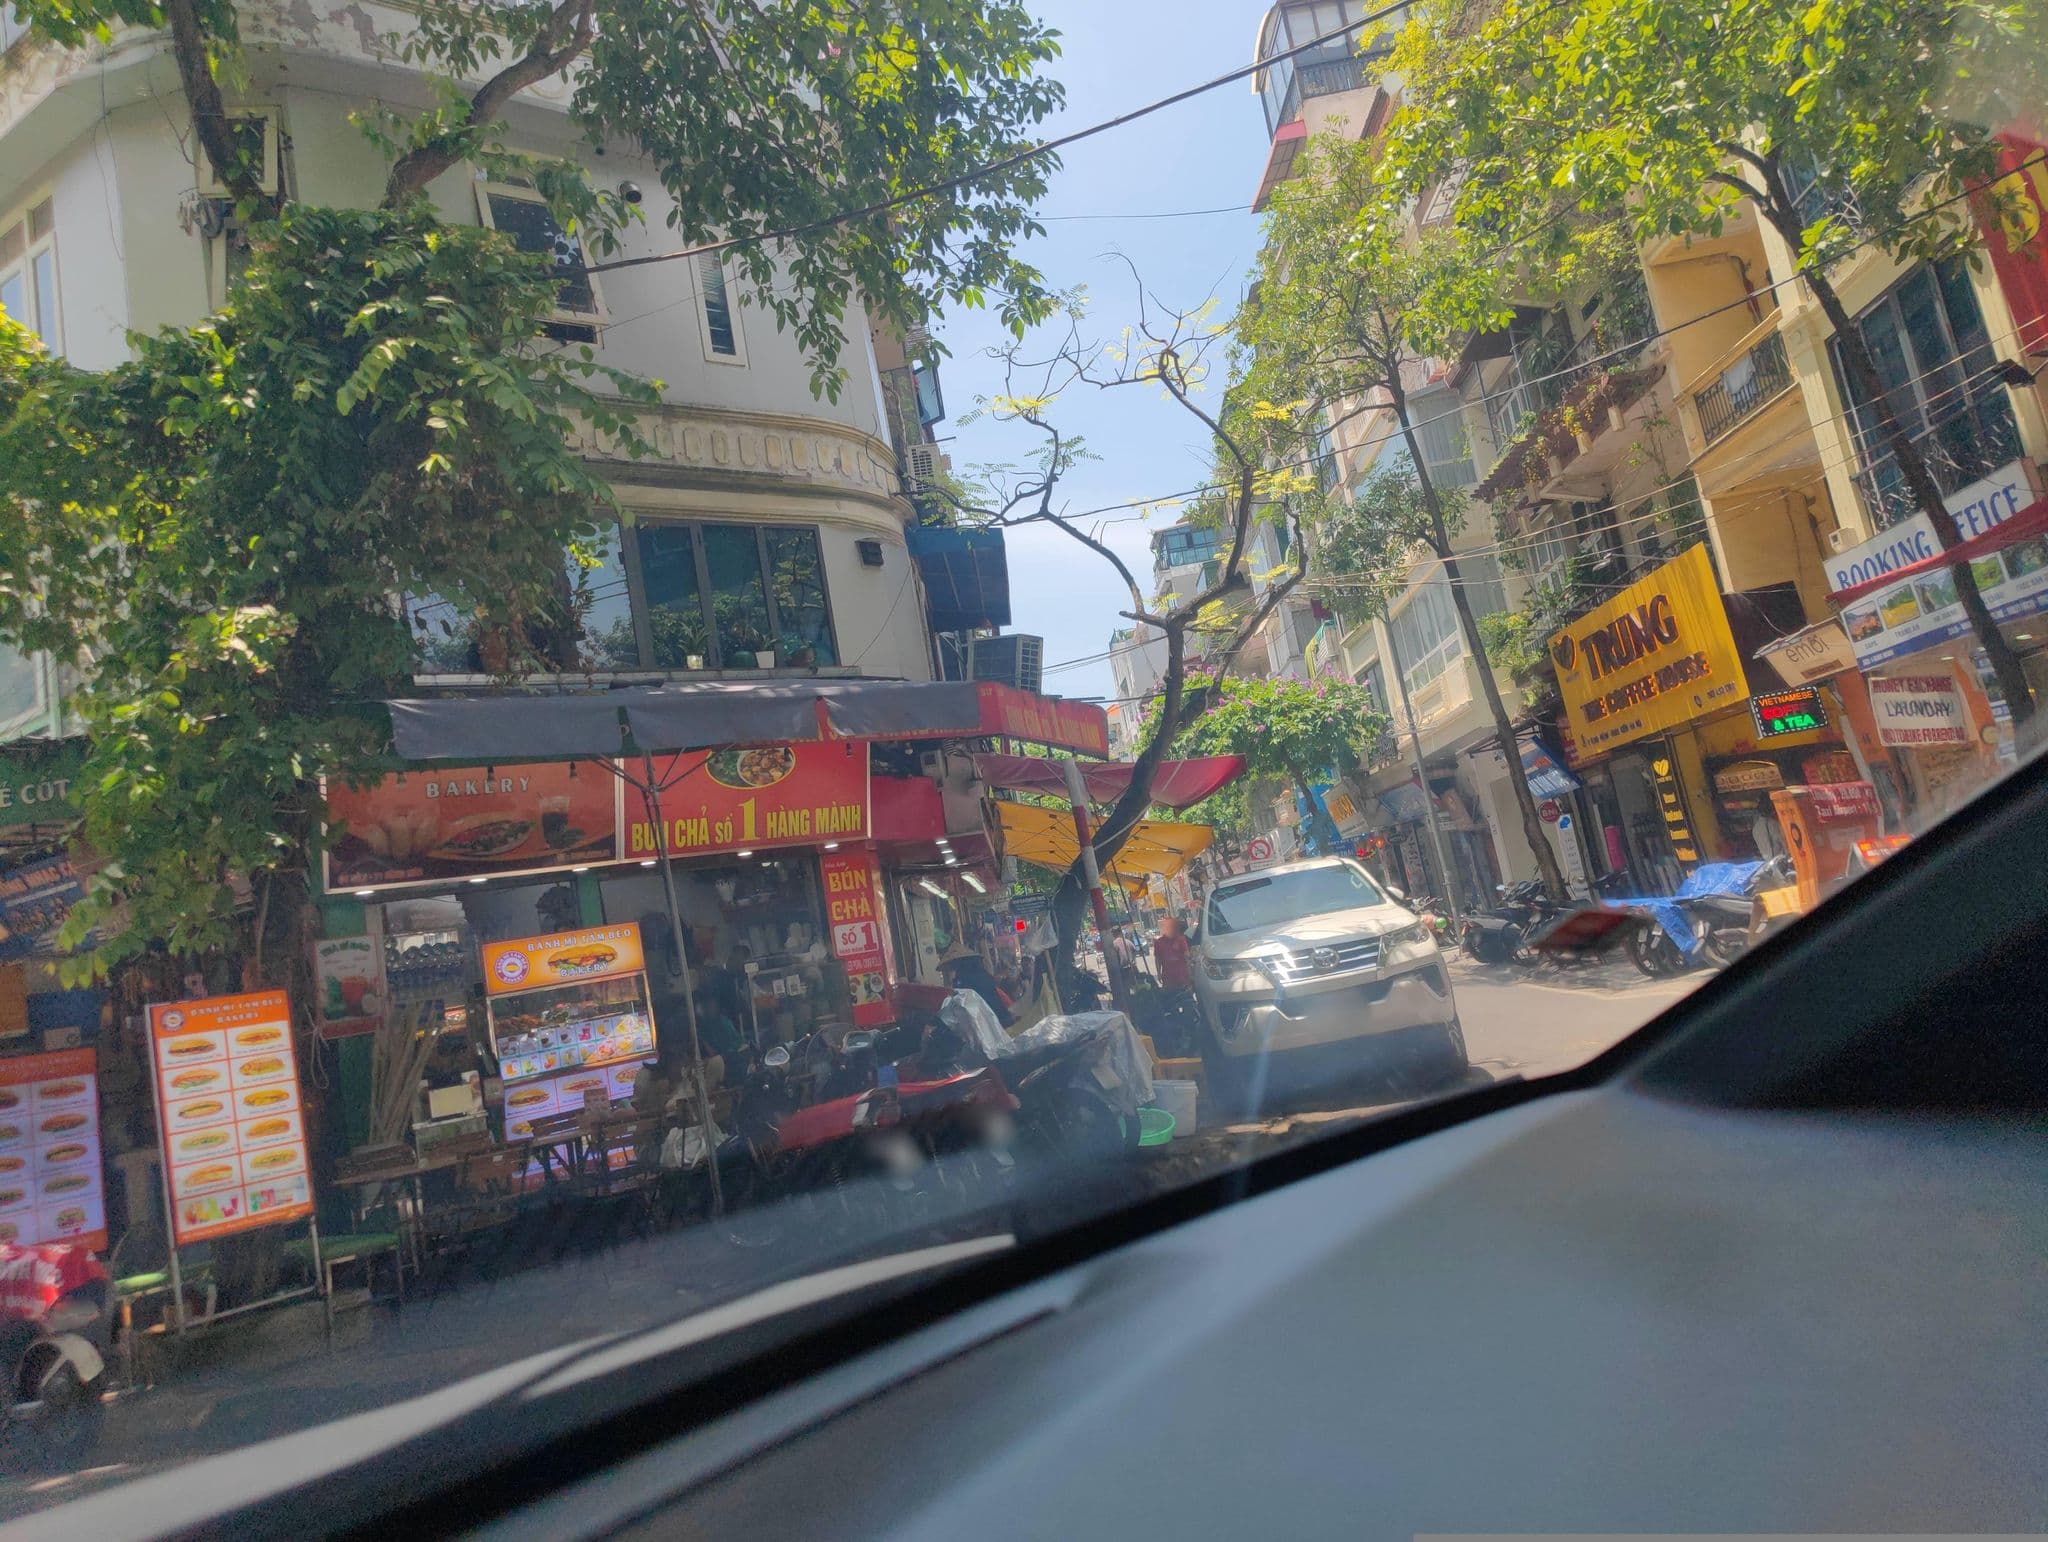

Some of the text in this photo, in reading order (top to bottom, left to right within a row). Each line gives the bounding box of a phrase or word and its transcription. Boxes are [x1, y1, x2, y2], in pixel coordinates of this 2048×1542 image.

[1836, 482, 2018, 588] BOOKING FFICE
[1578, 592, 1681, 683] TRUNG
[1758, 690, 1815, 707] VIETNAMESE
[1885, 702, 1952, 718] LAUNDRY
[1785, 713, 1816, 729] TEA
[425, 775, 532, 798] BAKERY
[674, 807, 710, 848] CHẢ
[738, 798, 760, 841] 1
[766, 803, 810, 838] HÀNG
[815, 800, 862, 834] MÀNH
[828, 866, 867, 893] BÚN
[831, 892, 872, 921] CHẢ
[860, 923, 877, 950] 1
[560, 961, 609, 977] BAKERY
